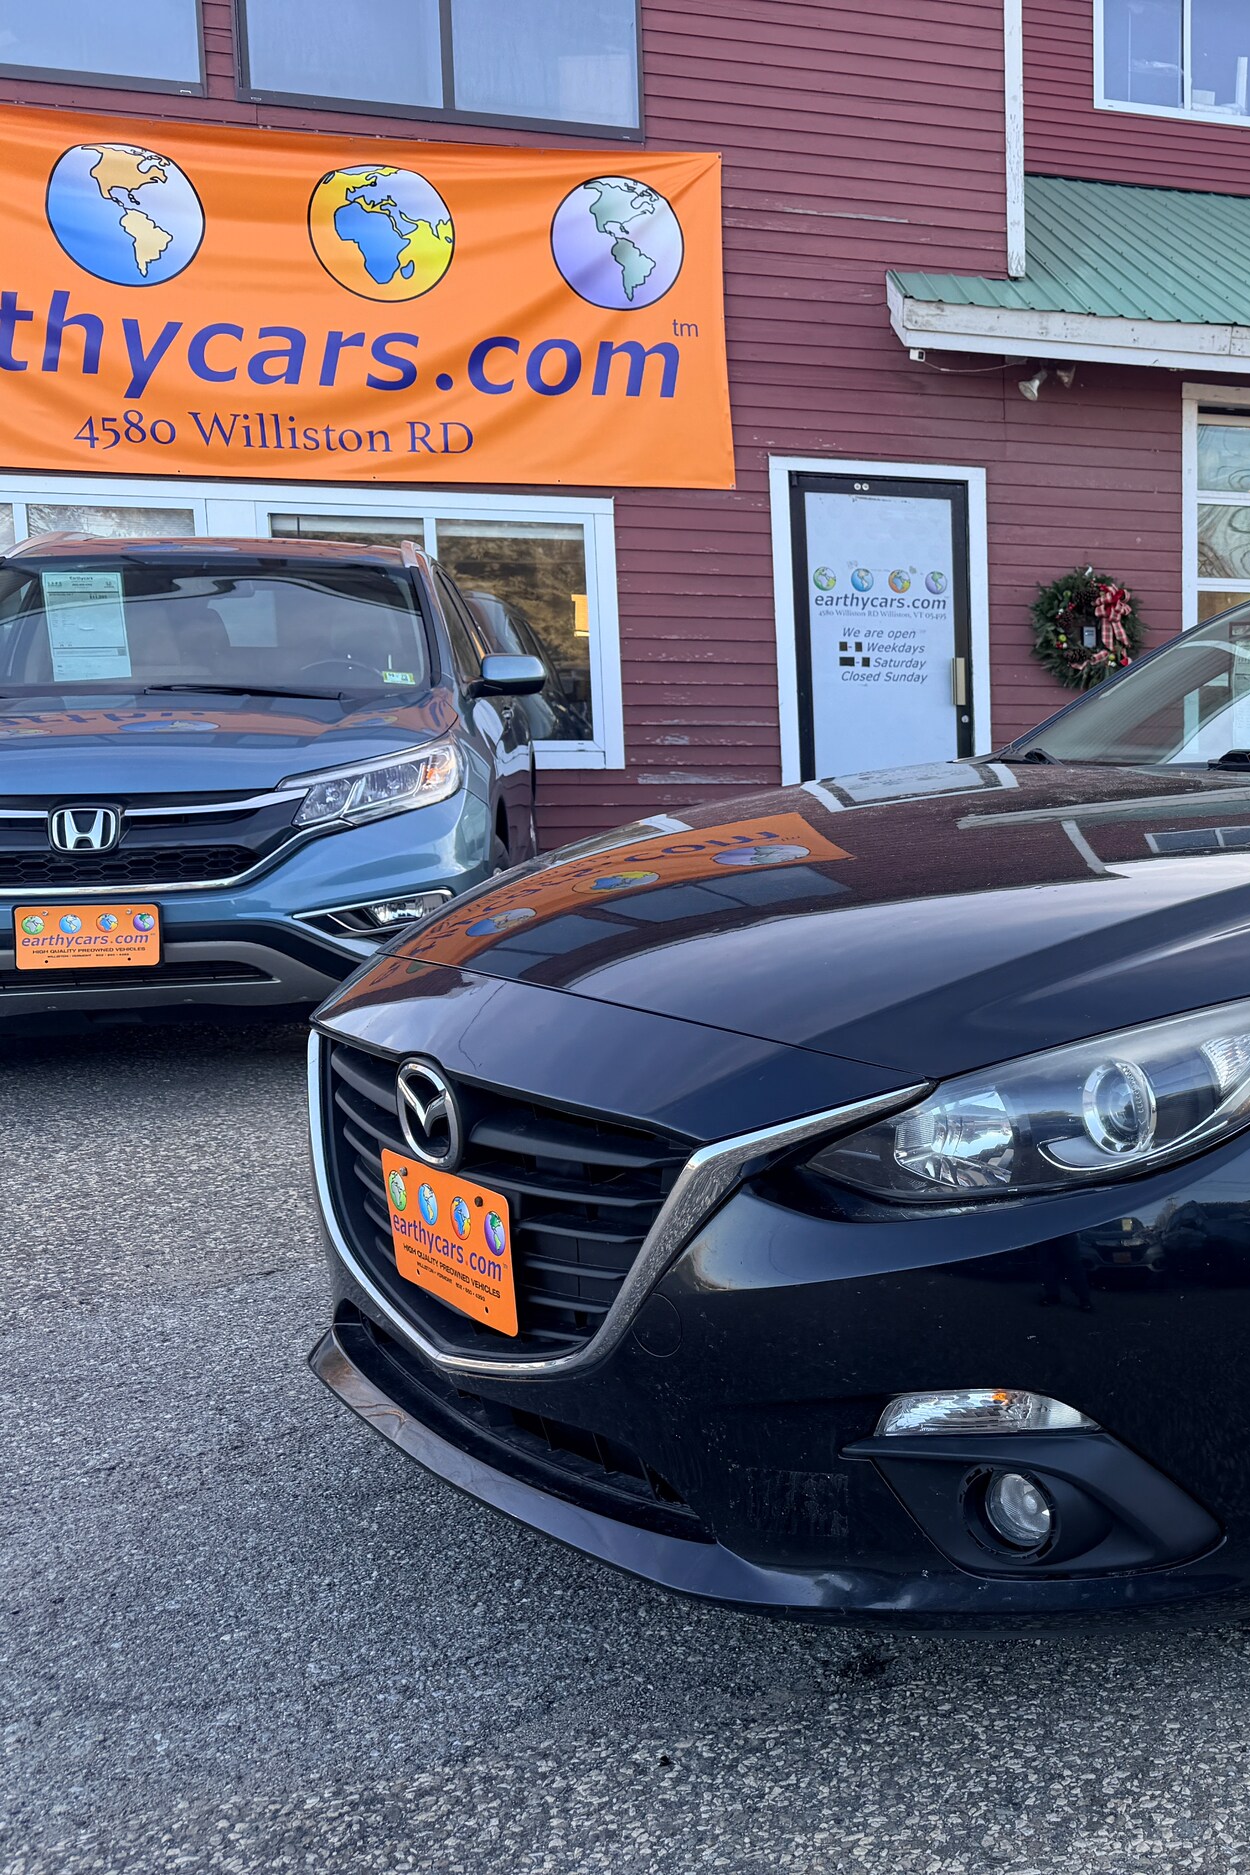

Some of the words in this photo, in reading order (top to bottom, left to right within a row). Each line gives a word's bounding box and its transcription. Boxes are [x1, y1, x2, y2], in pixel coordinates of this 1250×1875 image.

[0, 290, 680, 398] thycars.com
[672, 319, 698, 337] tm
[74, 410, 177, 450] 4580
[187, 412, 391, 454] Williston
[407, 421, 474, 455] RD
[814, 592, 947, 611] earthycars.com
[835, 609, 866, 617] Williston
[842, 627, 860, 638] We
[864, 629, 884, 639] are
[887, 630, 916, 640] open
[867, 642, 925, 655] Weekdays
[873, 657, 926, 670] Saturday
[841, 671, 881, 682] Closed
[884, 672, 928, 684] Sunday
[21, 934, 149, 948] earthycars.com
[393, 1214, 502, 1282] earthycars.com
[403, 1243, 416, 1255] HIGH
[417, 1250, 438, 1267] QUALITY
[439, 1261, 470, 1284] PREOWNED
[471, 1278, 501, 1299] VEHICLES
